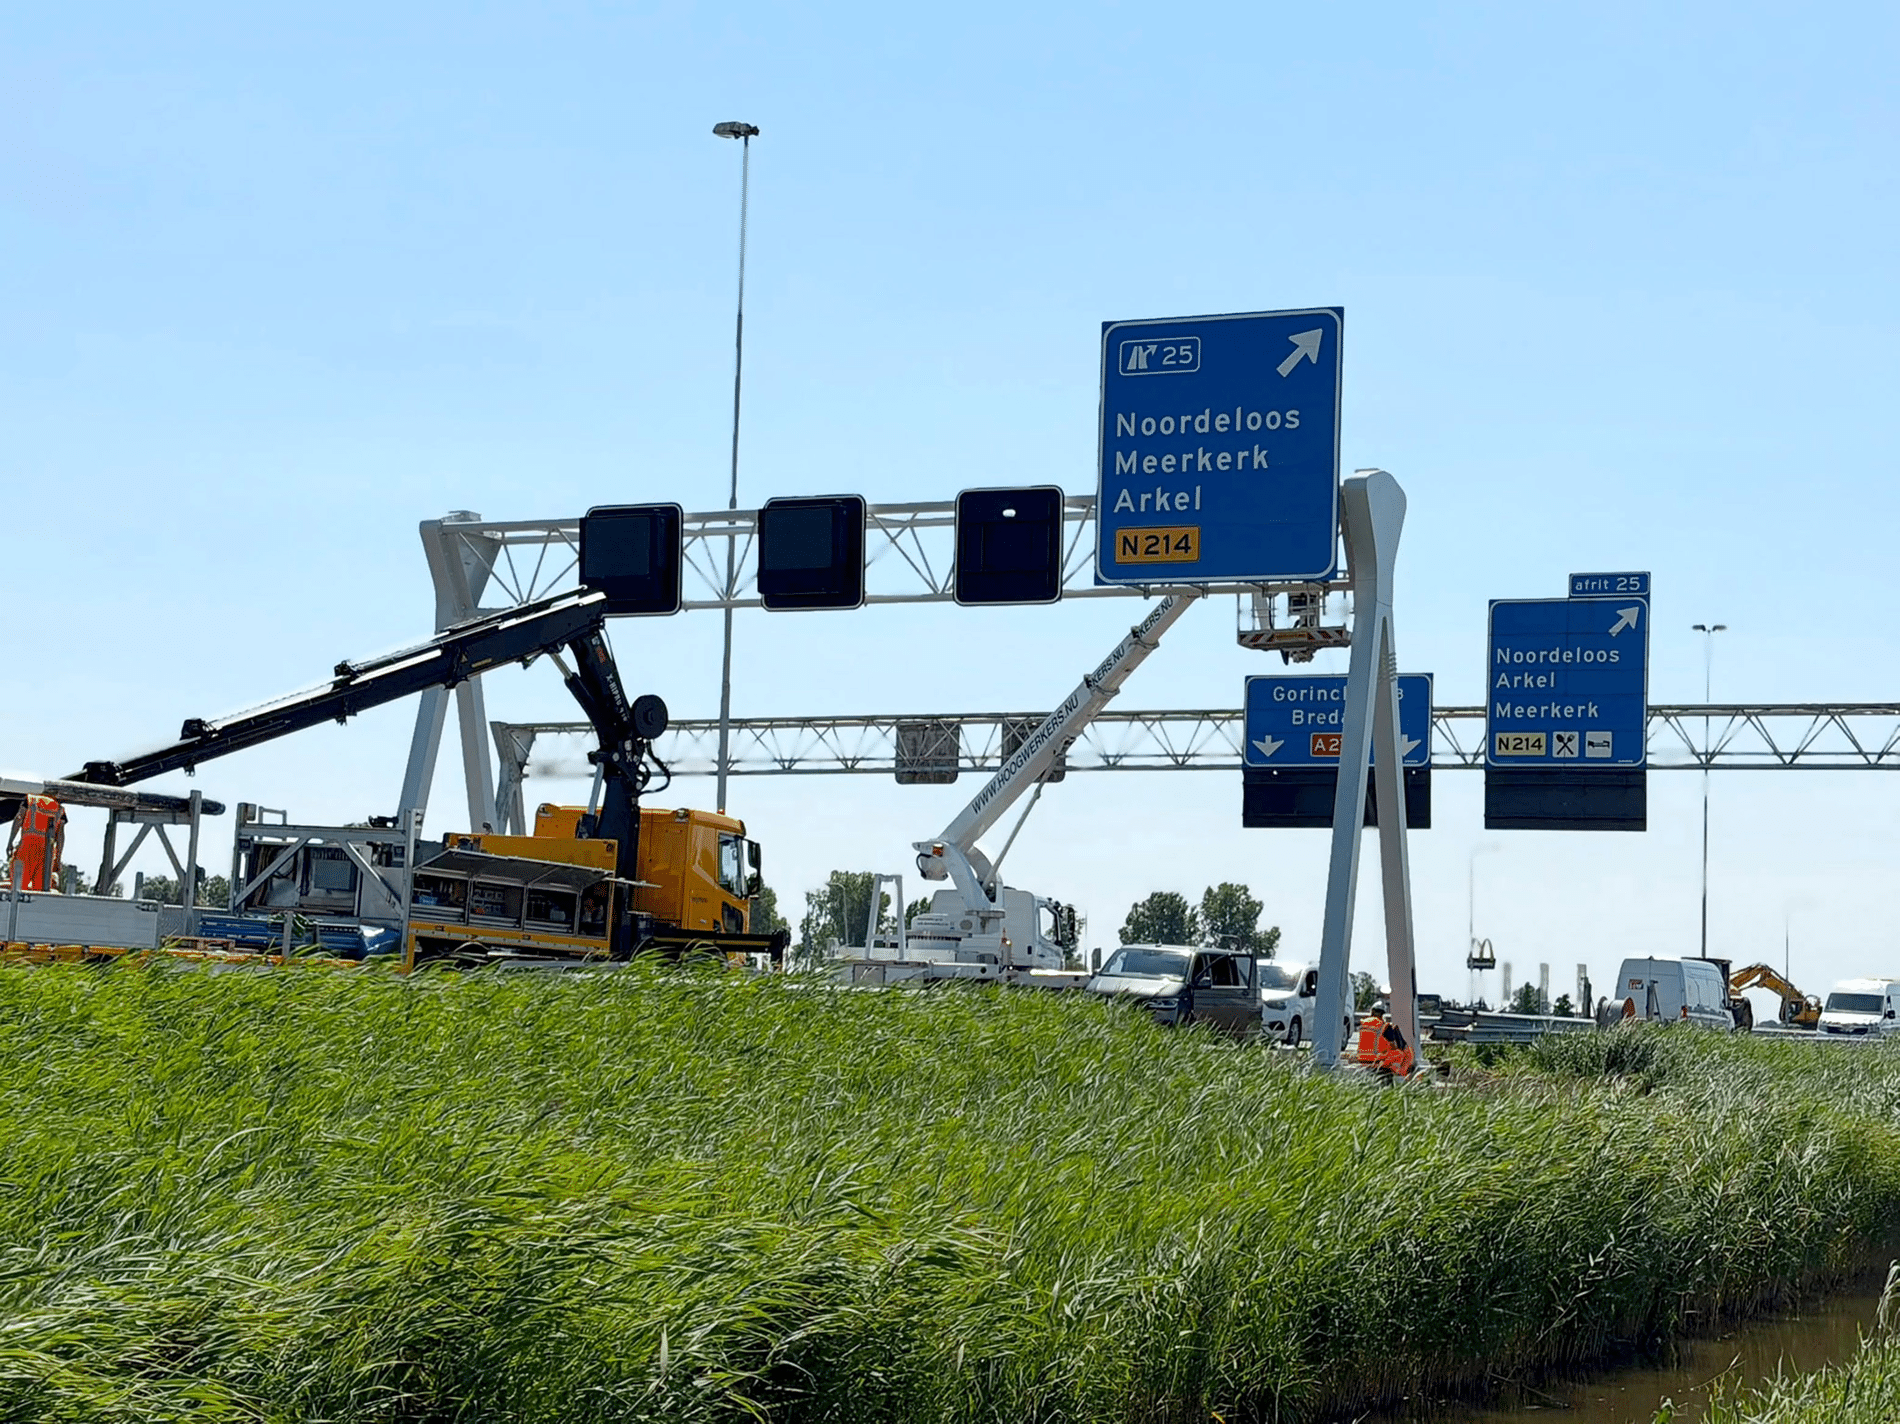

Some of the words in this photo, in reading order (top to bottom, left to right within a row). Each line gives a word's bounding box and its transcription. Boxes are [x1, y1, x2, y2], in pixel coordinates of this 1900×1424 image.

[1162, 345, 1193, 366] 25
[1116, 406, 1300, 438] Noordeloos
[1115, 444, 1268, 475] Meerkerk
[1113, 485, 1201, 513] Arkel
[1121, 533, 1192, 556] N214
[1575, 579, 1609, 591] afrit
[1616, 576, 1641, 591] 25
[1138, 596, 1174, 638] KERS.NU
[1091, 645, 1125, 686] KERS.NU
[1496, 647, 1620, 664] Noordeloos
[1496, 671, 1556, 688] Arkel
[1292, 709, 1344, 725] Bred
[1495, 701, 1599, 719] Meerkerk
[971, 694, 1079, 814] WWW.HOOGWERKERS.NU
[1313, 737, 1342, 752] A2
[1498, 736, 1543, 751] N214
